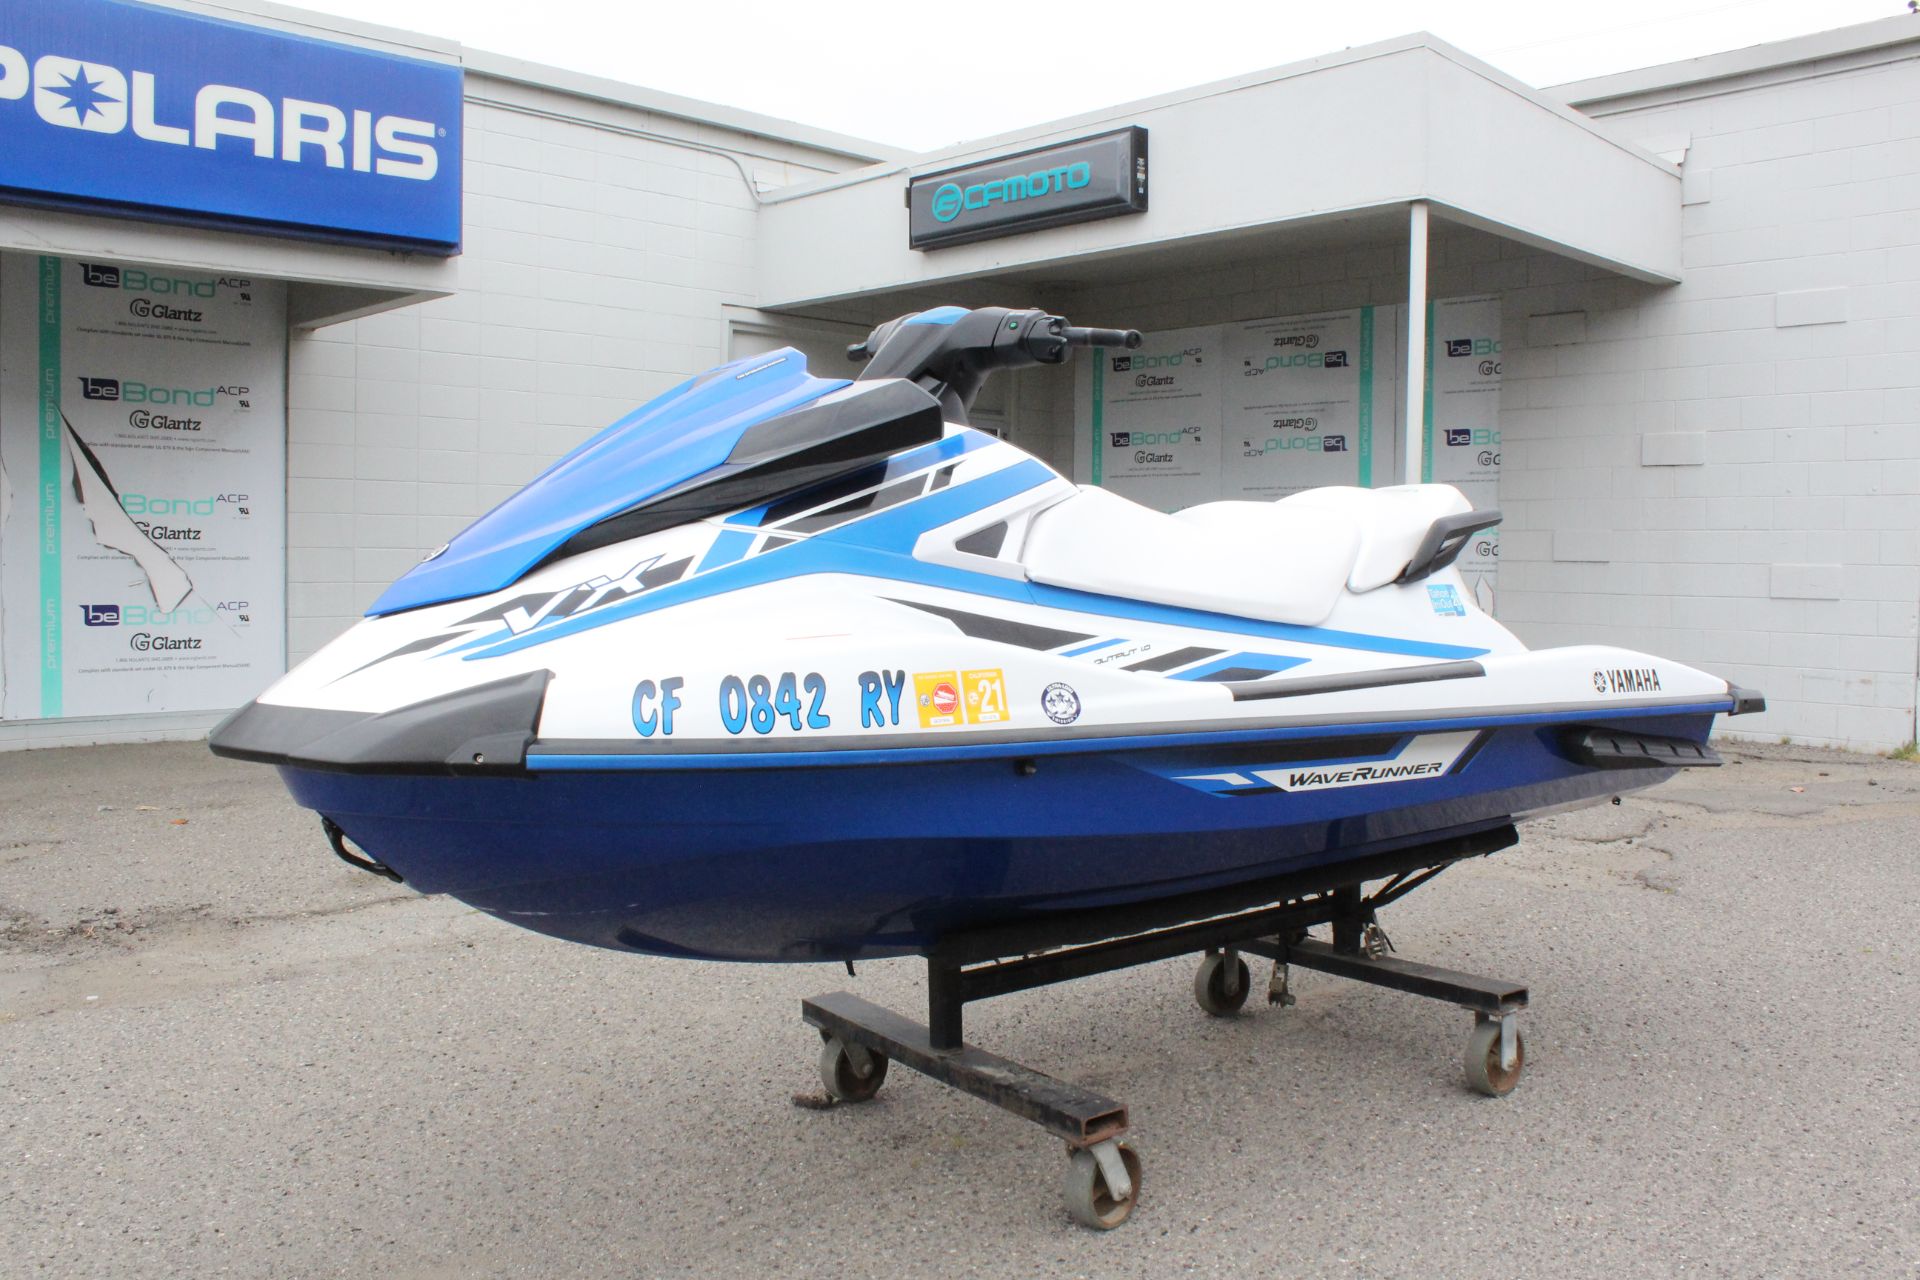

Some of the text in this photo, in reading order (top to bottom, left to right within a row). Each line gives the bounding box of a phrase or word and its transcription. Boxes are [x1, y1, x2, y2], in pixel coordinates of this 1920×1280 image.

[964, 161, 1091, 209] CFMOTO
[151, 304, 203, 322] Glantz
[150, 415, 202, 431] Glantz
[152, 636, 202, 651] Glantz
[1094, 648, 1137, 665] OUTPUT
[1606, 669, 1662, 693] YAMAHA
[631, 669, 905, 737] CF 0842 RY
[978, 678, 1005, 713] 21
